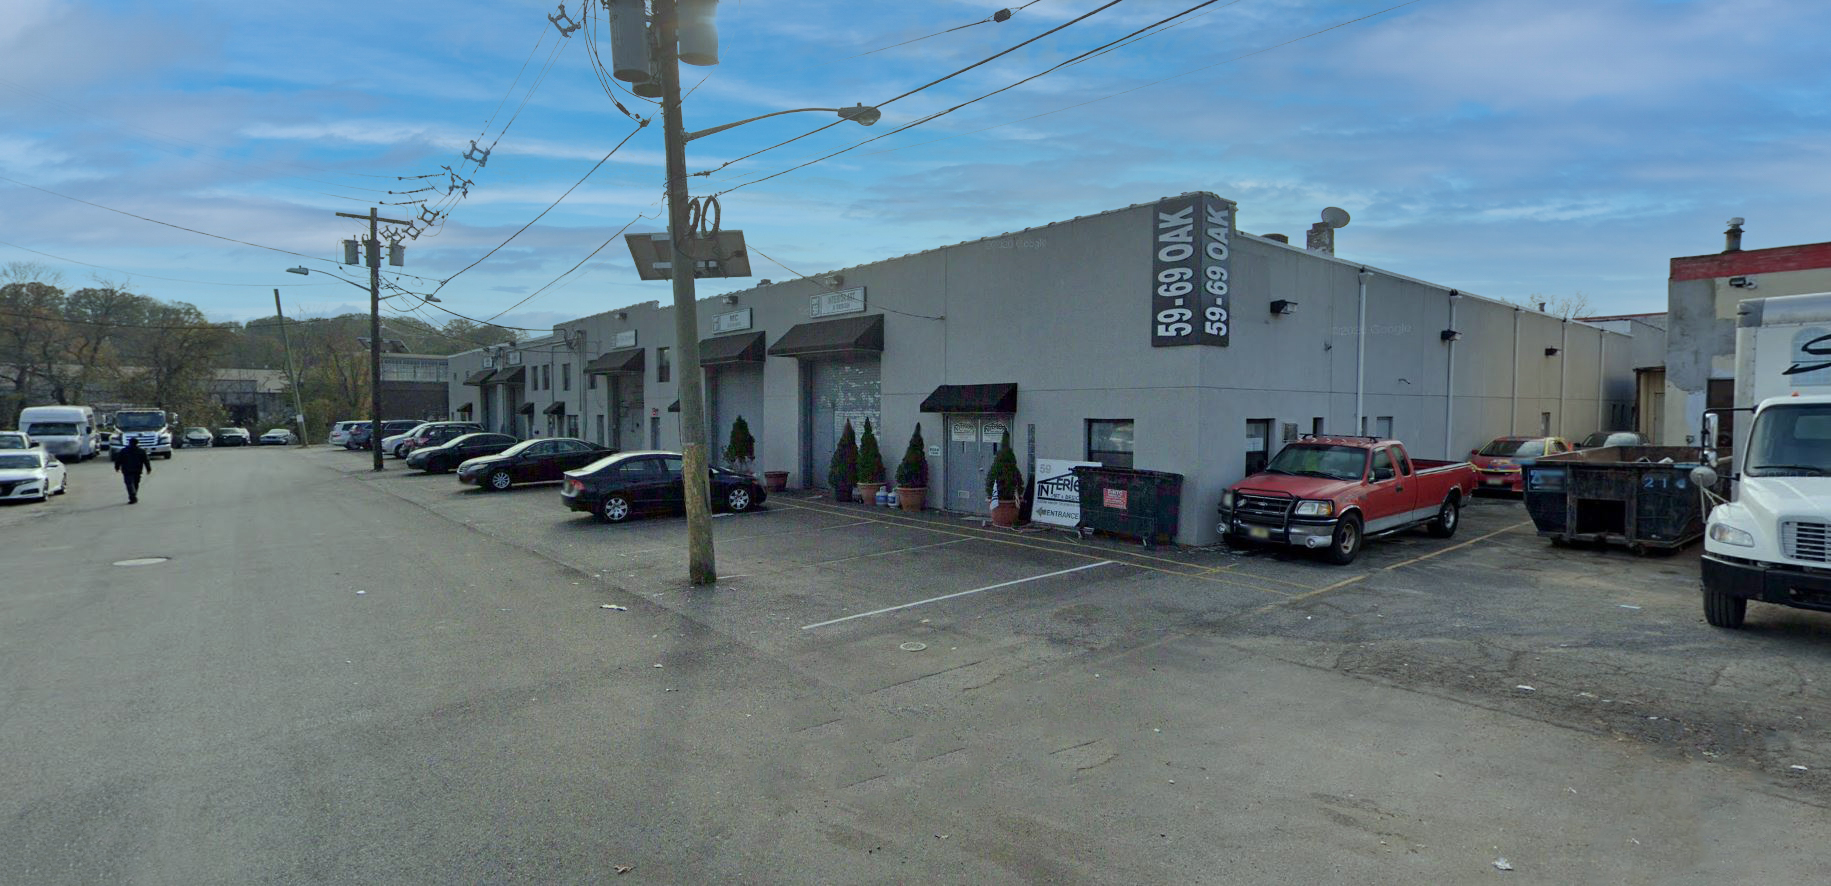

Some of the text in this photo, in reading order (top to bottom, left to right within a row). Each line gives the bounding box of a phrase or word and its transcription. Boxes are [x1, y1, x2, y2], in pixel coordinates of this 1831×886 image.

[1157, 205, 1194, 337] 59-69 OAK
[1204, 203, 1229, 337] 59-69 OAK
[1039, 463, 1052, 474] 59
[1046, 509, 1080, 520] ENTRANCE
